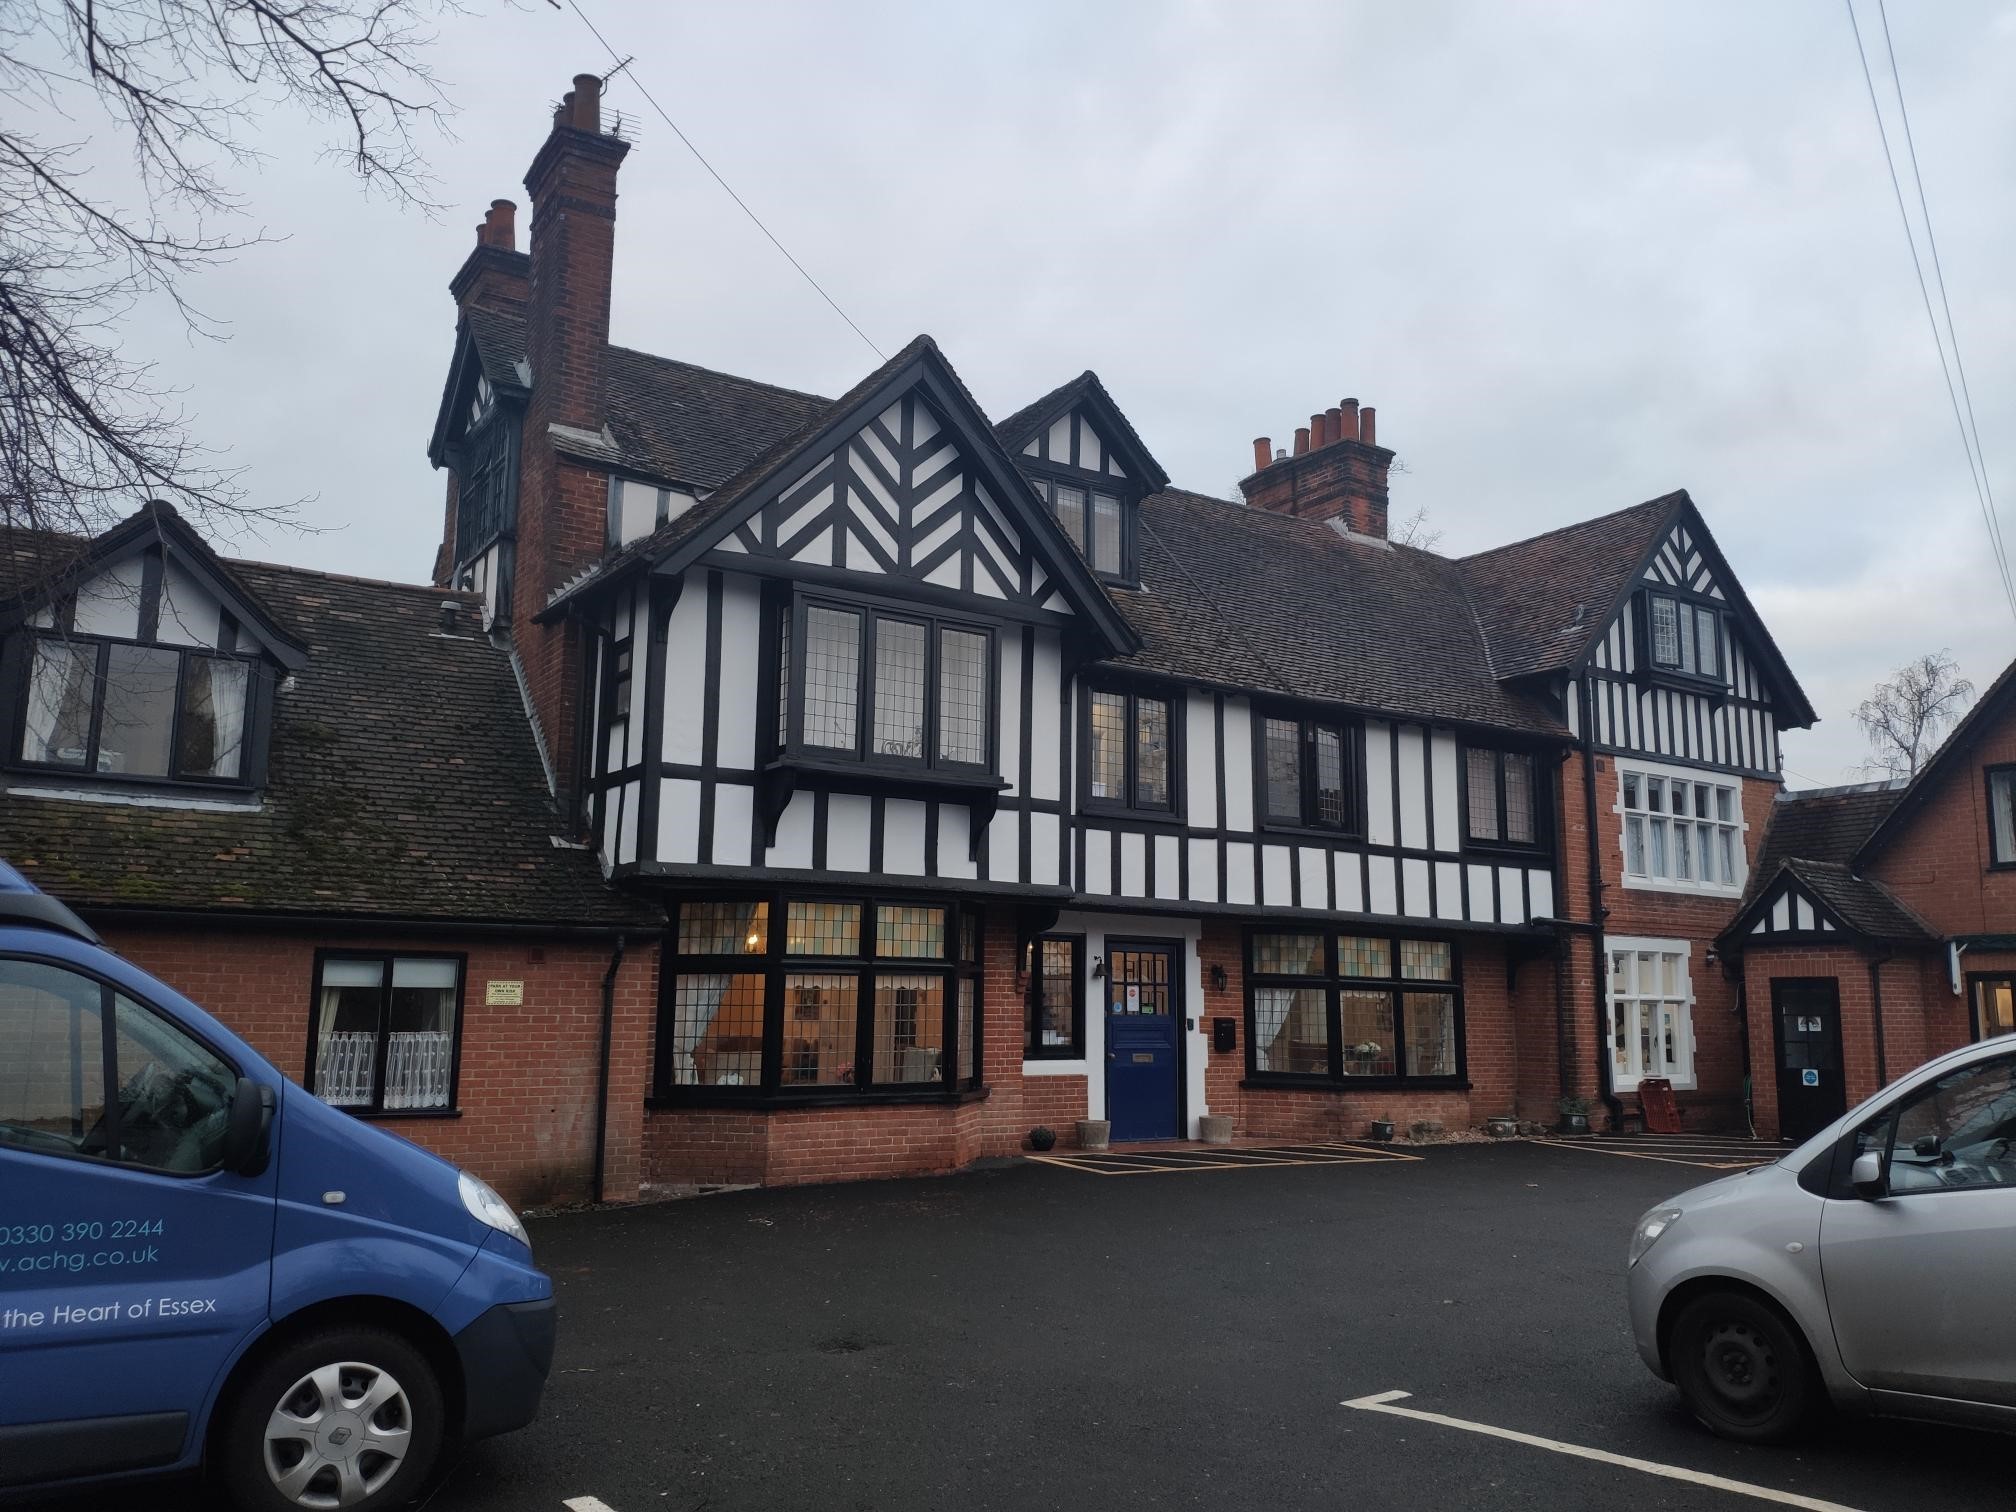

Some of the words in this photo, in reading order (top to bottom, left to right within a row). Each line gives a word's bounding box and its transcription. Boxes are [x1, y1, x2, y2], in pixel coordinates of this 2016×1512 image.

[0, 1224, 54, 1246] 0330
[62, 1222, 103, 1241] 390
[111, 1219, 164, 1238] 2244
[3, 1308, 45, 1329] the
[53, 1301, 120, 1325] Heart
[128, 1298, 152, 1319] of
[159, 1297, 216, 1316] Essex
